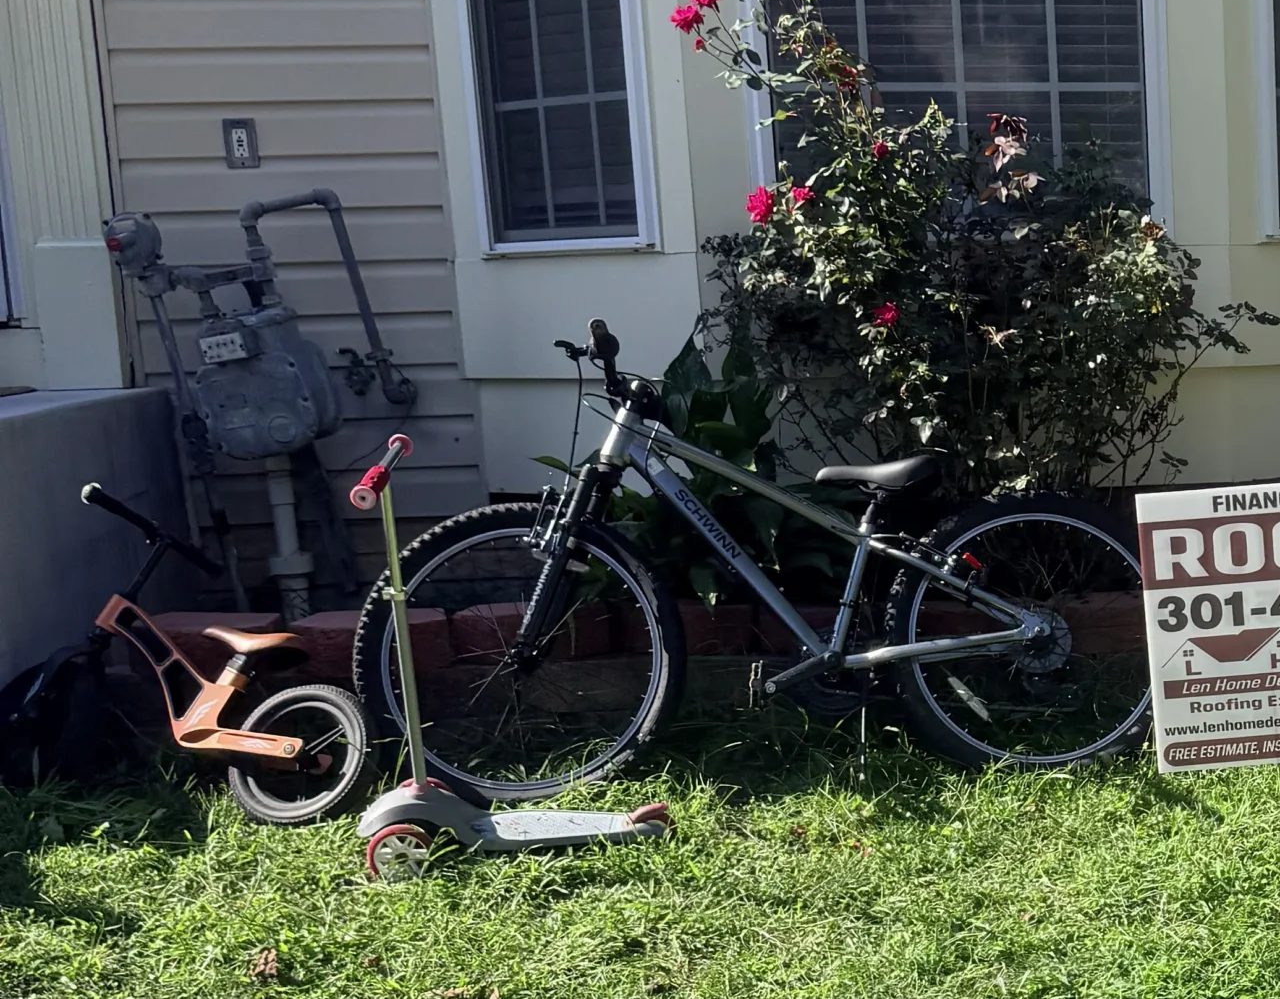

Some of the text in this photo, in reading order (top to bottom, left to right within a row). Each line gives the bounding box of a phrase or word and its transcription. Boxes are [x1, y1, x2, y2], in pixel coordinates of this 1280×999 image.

[674, 489, 741, 560] SCHWINN
[1185, 660, 1202, 676] L
[1182, 681, 1210, 695] Len
[1215, 678, 1260, 691] Home
[1190, 697, 1263, 714] Roofing
[1168, 746, 1198, 761] FREE
[1200, 741, 1260, 758] ESTIMATE,
